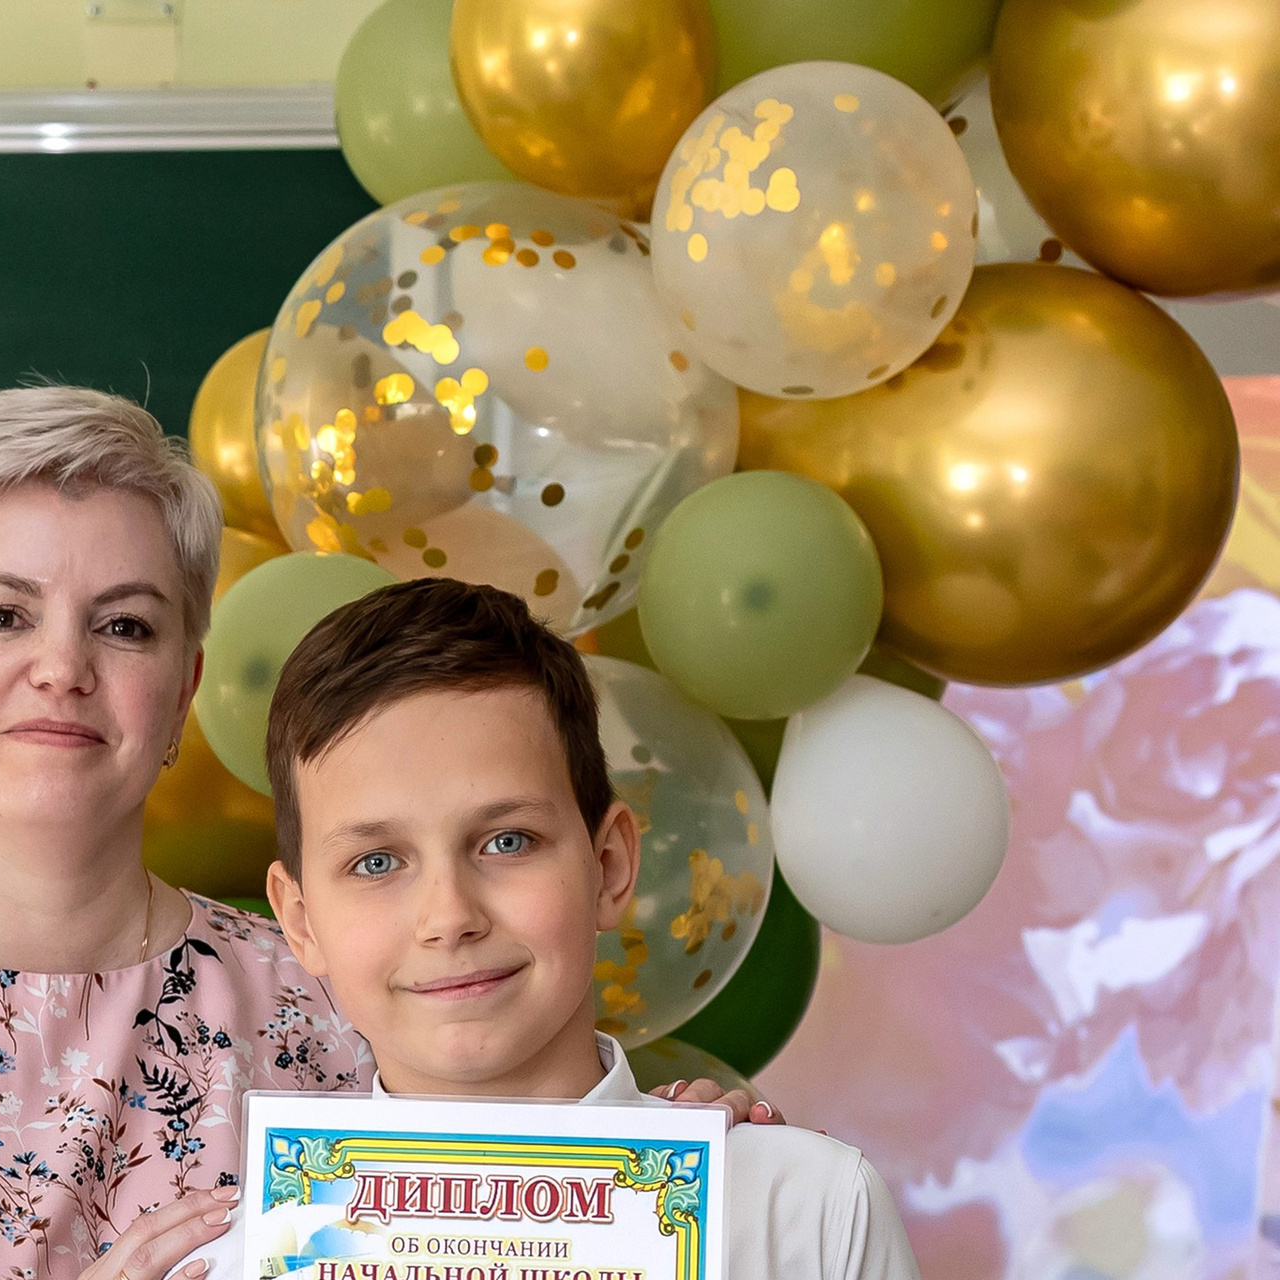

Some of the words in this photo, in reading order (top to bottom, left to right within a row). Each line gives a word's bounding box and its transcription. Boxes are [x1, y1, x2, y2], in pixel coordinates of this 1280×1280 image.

[348, 1173, 613, 1221] ДИПЛОМ
[391, 1236, 419, 1254] ОБ
[426, 1238, 569, 1258] ОКОНЧАНИИ
